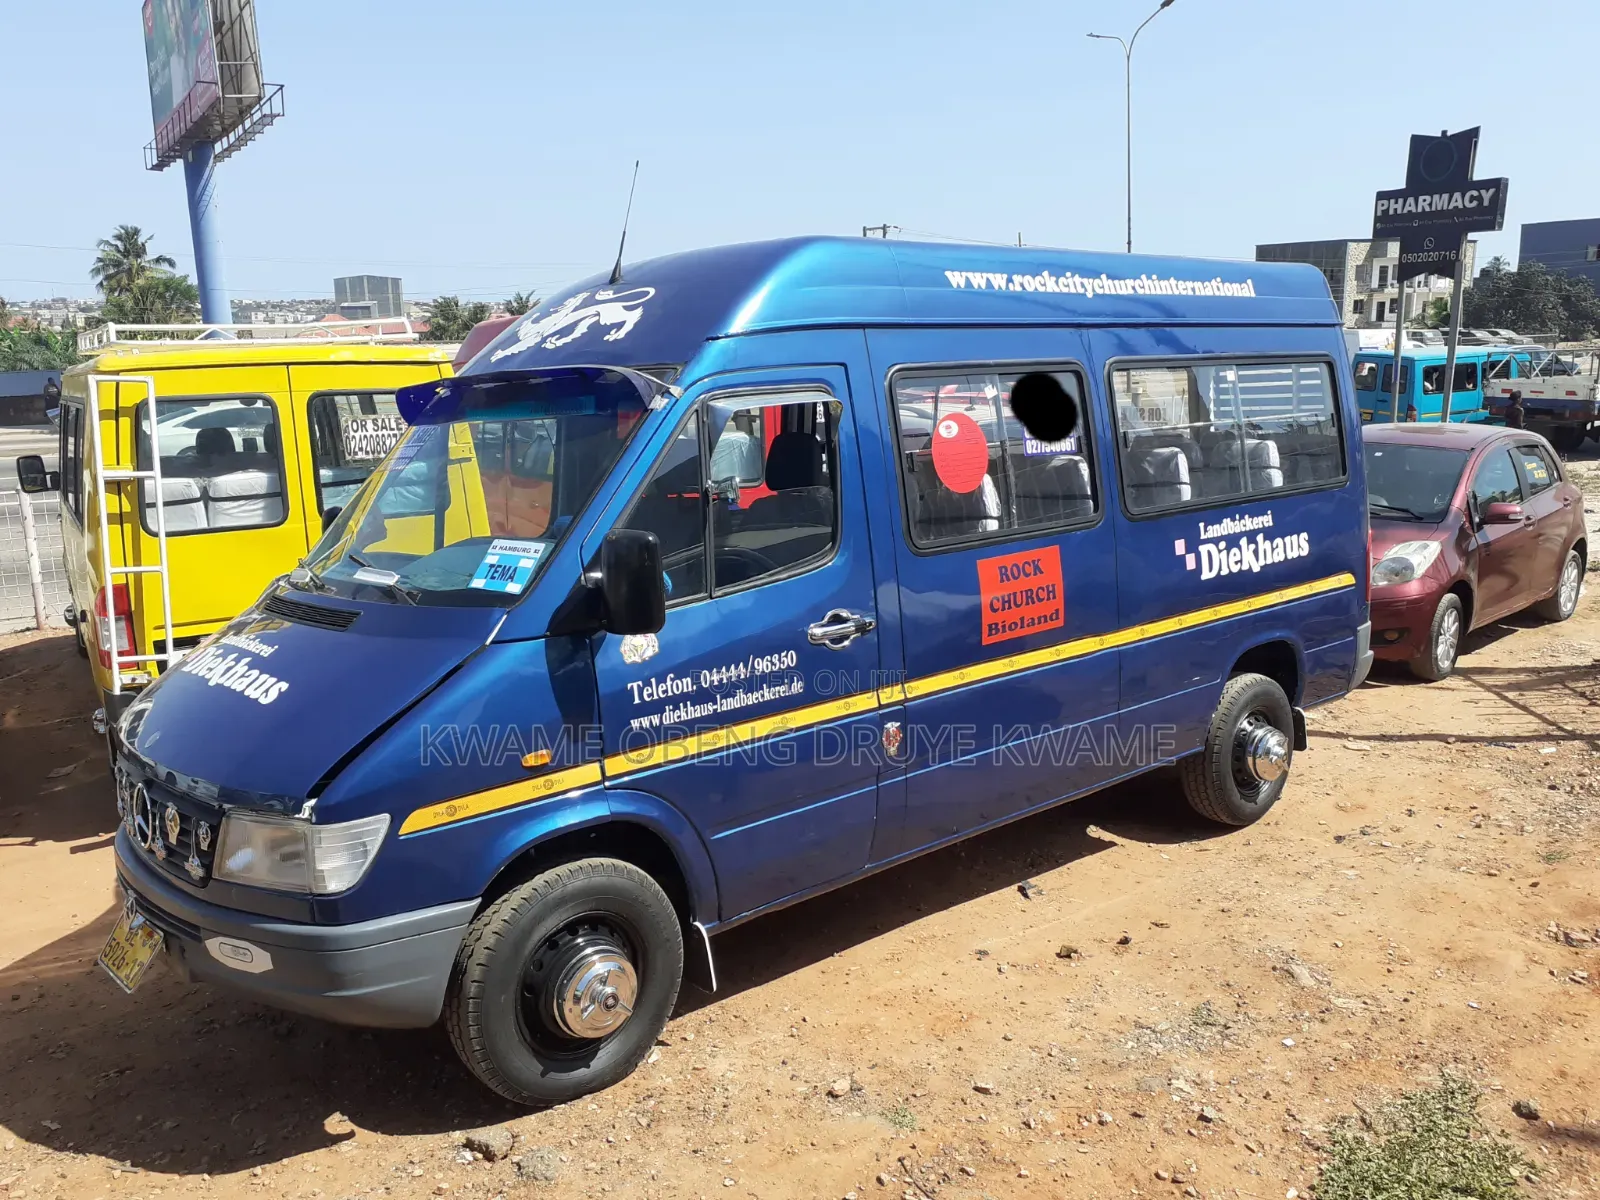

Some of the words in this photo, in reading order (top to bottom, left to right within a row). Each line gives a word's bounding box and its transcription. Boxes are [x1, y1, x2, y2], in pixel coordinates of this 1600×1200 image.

[1376, 188, 1496, 216] PHARMACY
[1401, 250, 1457, 264] 0502020716
[944, 270, 1255, 298] www.rockcitychurchinternational
[345, 432, 402, 457] 024208827
[498, 544, 532, 554] HAMBURG
[1198, 532, 1310, 580] Diekhaus
[484, 563, 518, 582] TEMA
[998, 558, 1044, 584] ROCK
[989, 584, 1057, 613] CHURCH
[987, 608, 1061, 637] Bioland
[181, 646, 289, 705] Diekhaus
[627, 673, 697, 704] Telefon.
